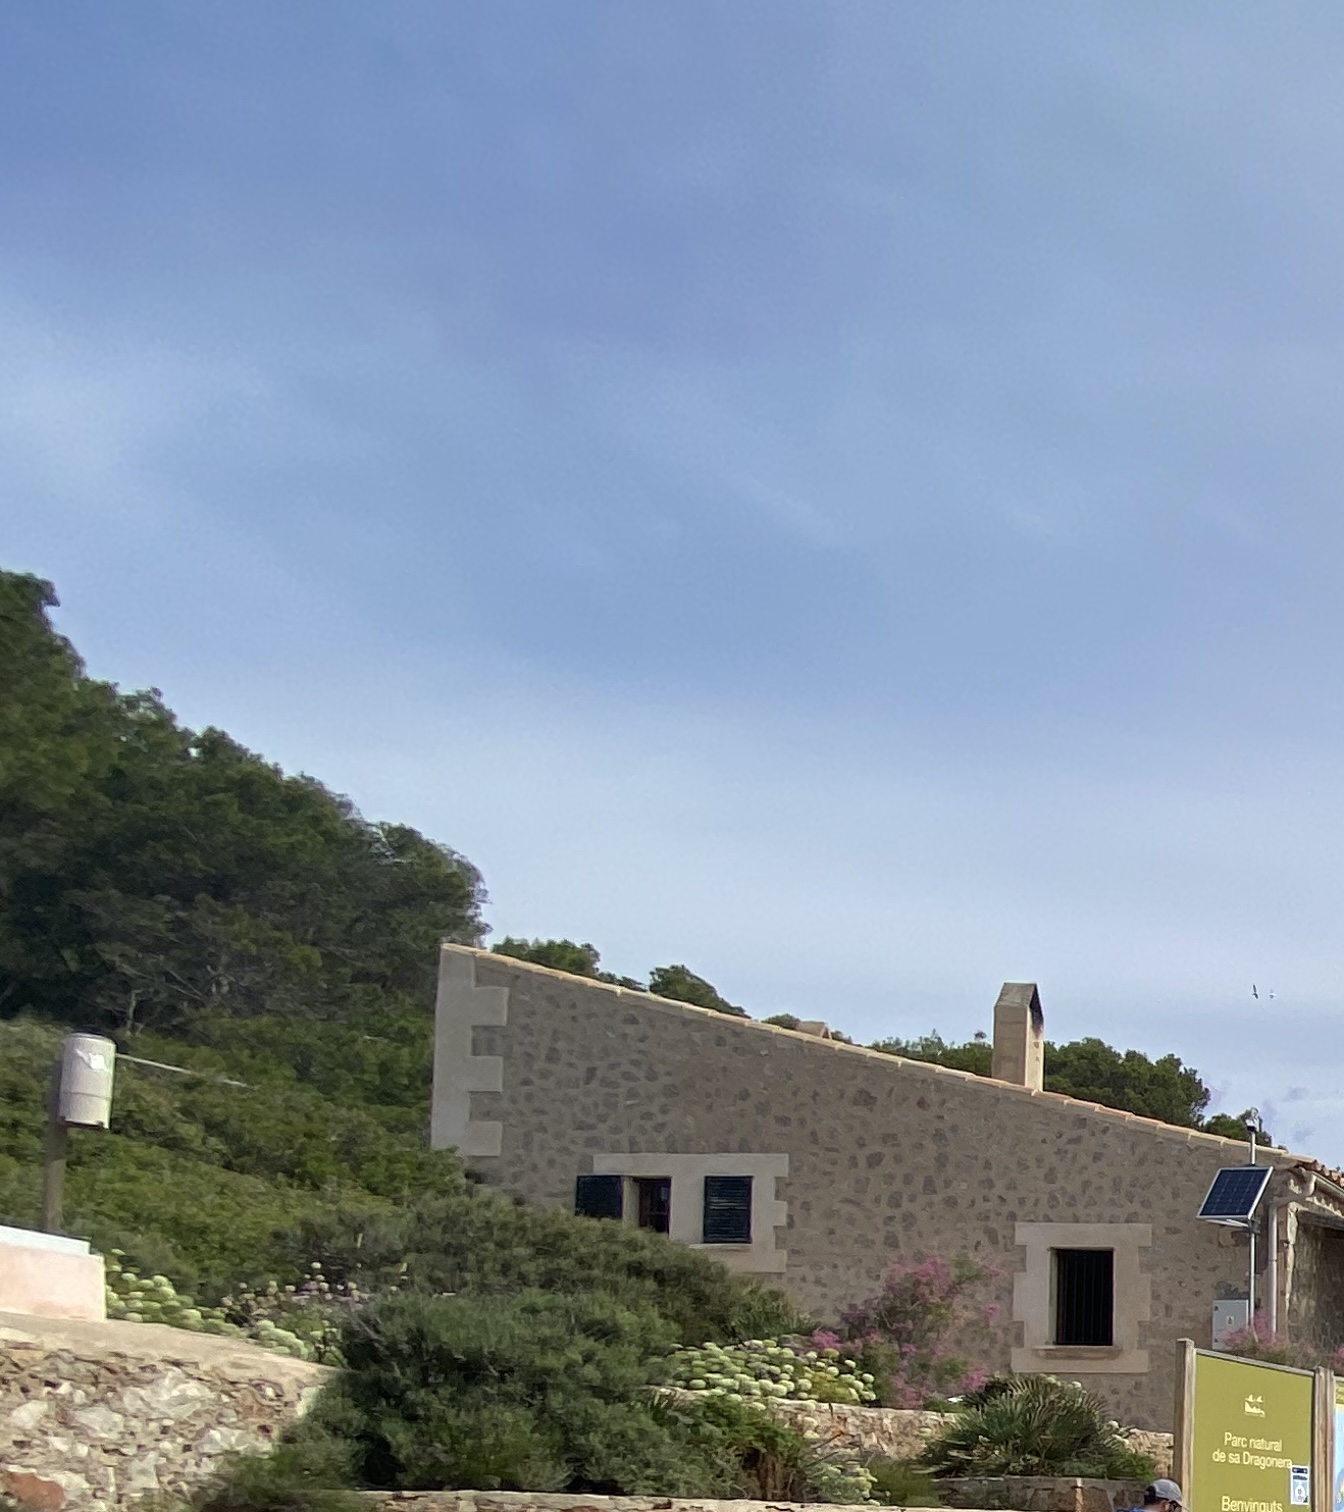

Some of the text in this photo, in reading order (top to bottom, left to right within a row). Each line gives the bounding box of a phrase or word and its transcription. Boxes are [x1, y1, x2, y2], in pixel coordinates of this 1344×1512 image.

[1224, 1431, 1283, 1452] Parc natural
[1212, 1448, 1293, 1469] de sa Dragonera
